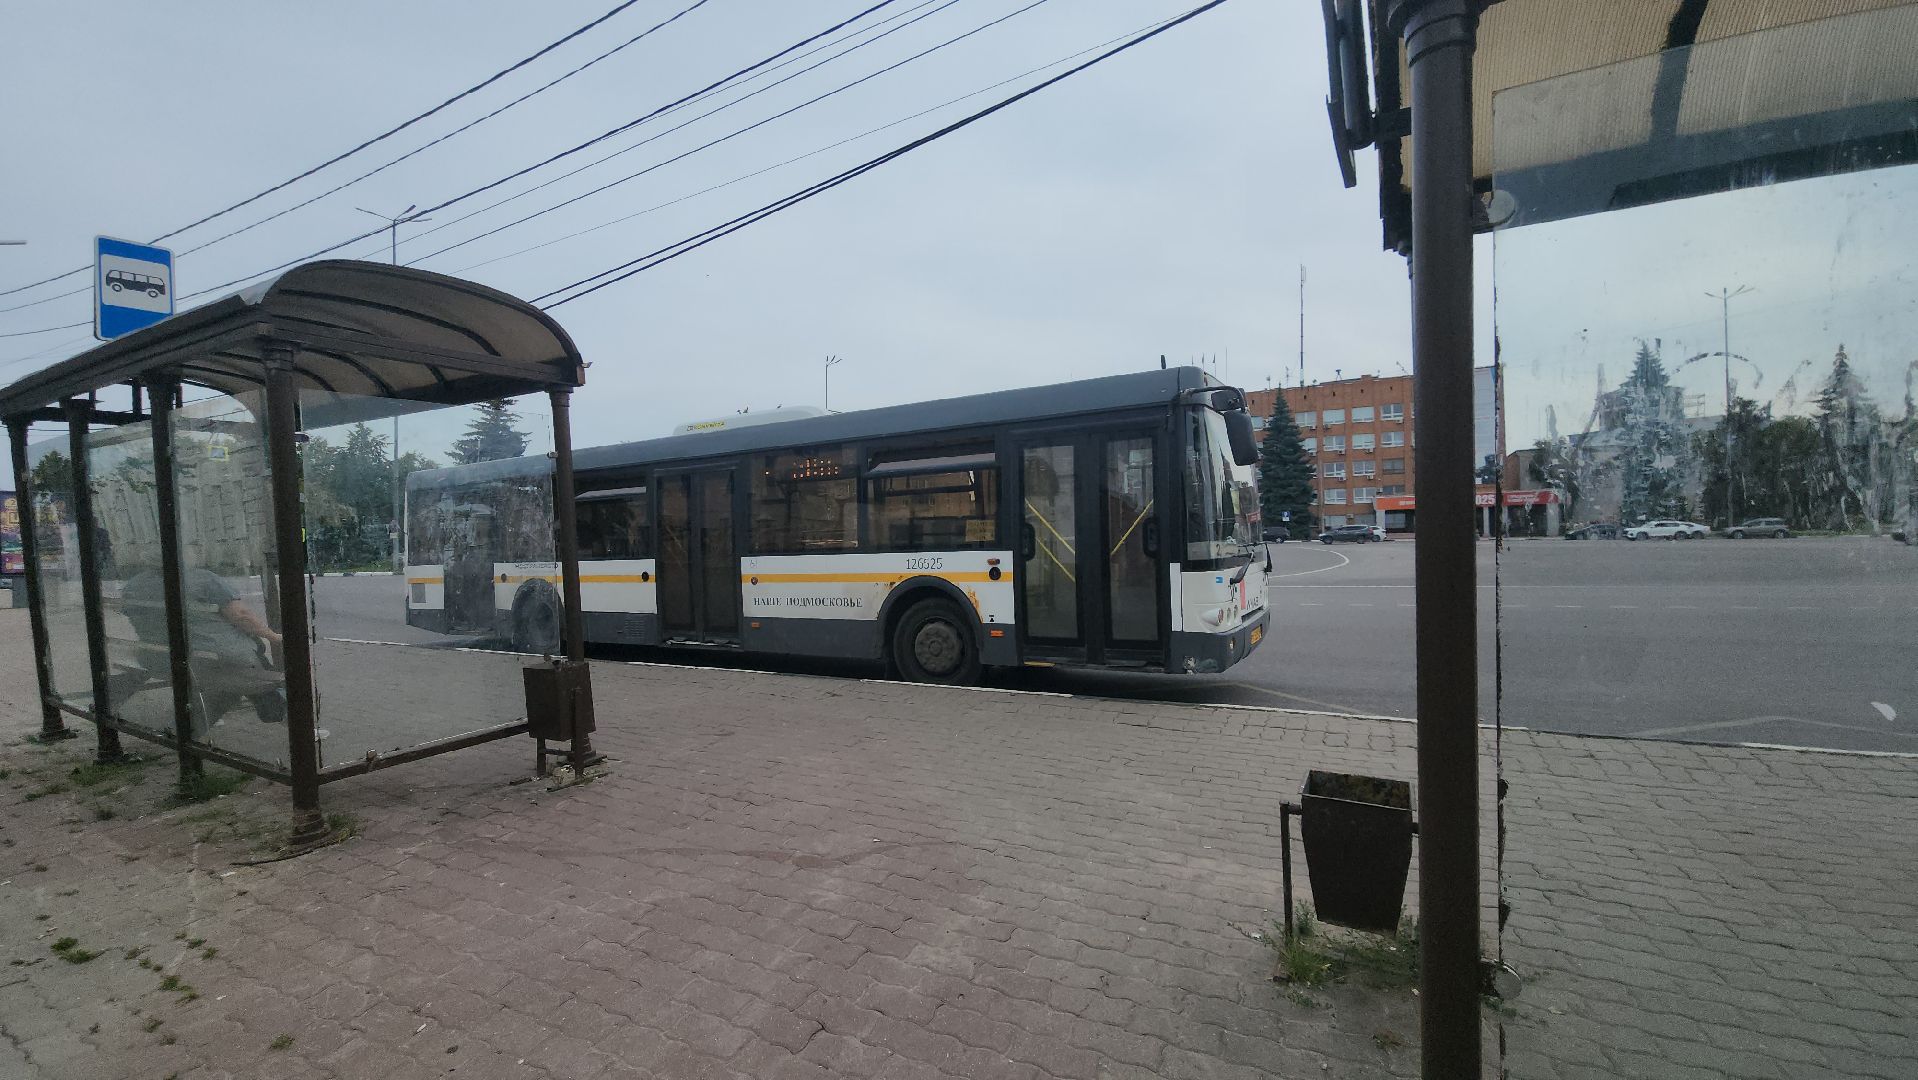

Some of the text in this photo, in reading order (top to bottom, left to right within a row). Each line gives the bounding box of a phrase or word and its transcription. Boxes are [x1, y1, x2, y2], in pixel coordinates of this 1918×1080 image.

[906, 557, 943, 570] 126525
[753, 597, 863, 608] НАШЕ ПОДМОСКОВЬЕ
